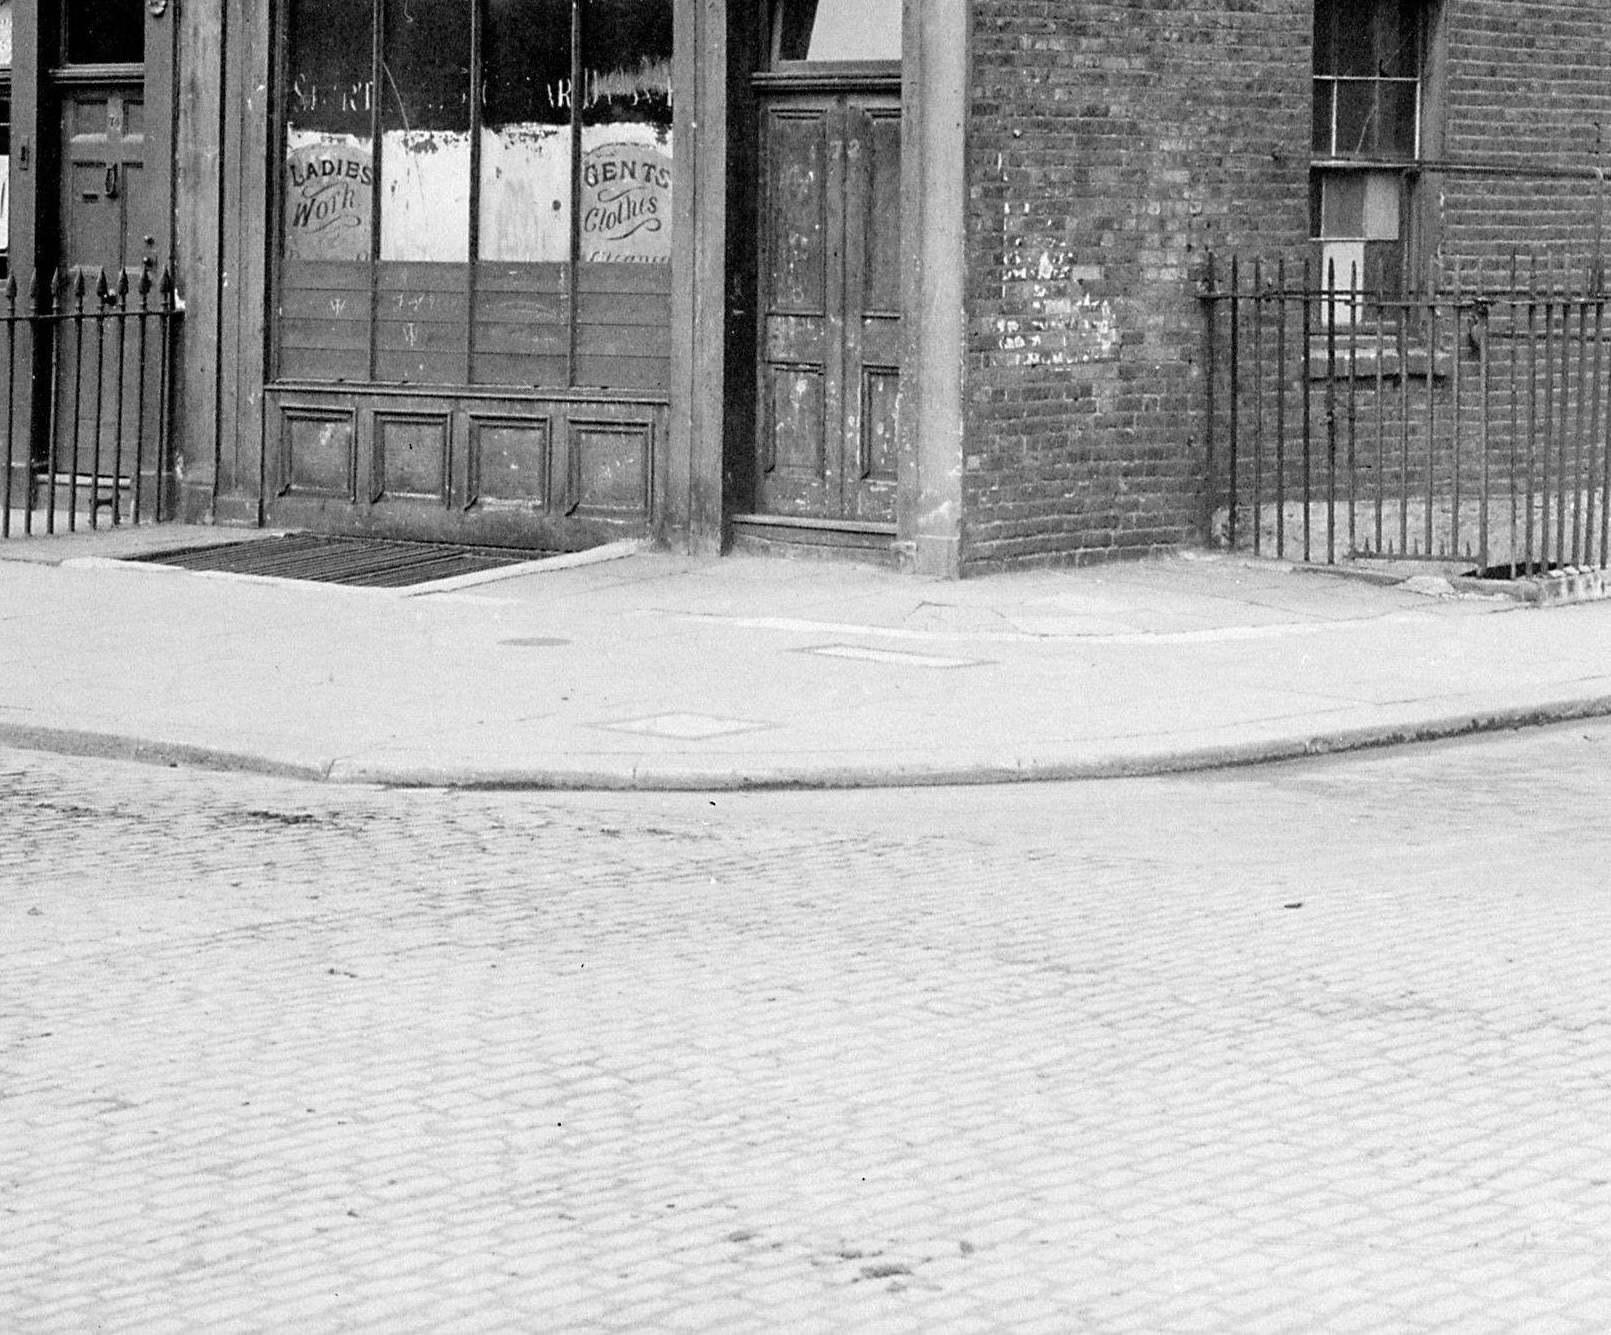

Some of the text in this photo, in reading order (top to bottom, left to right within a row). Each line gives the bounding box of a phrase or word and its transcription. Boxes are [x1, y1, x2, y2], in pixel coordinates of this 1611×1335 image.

[290, 159, 374, 187] LADIES
[585, 159, 671, 189] GENTS
[292, 187, 355, 229] Work
[584, 194, 659, 233] Clothes
